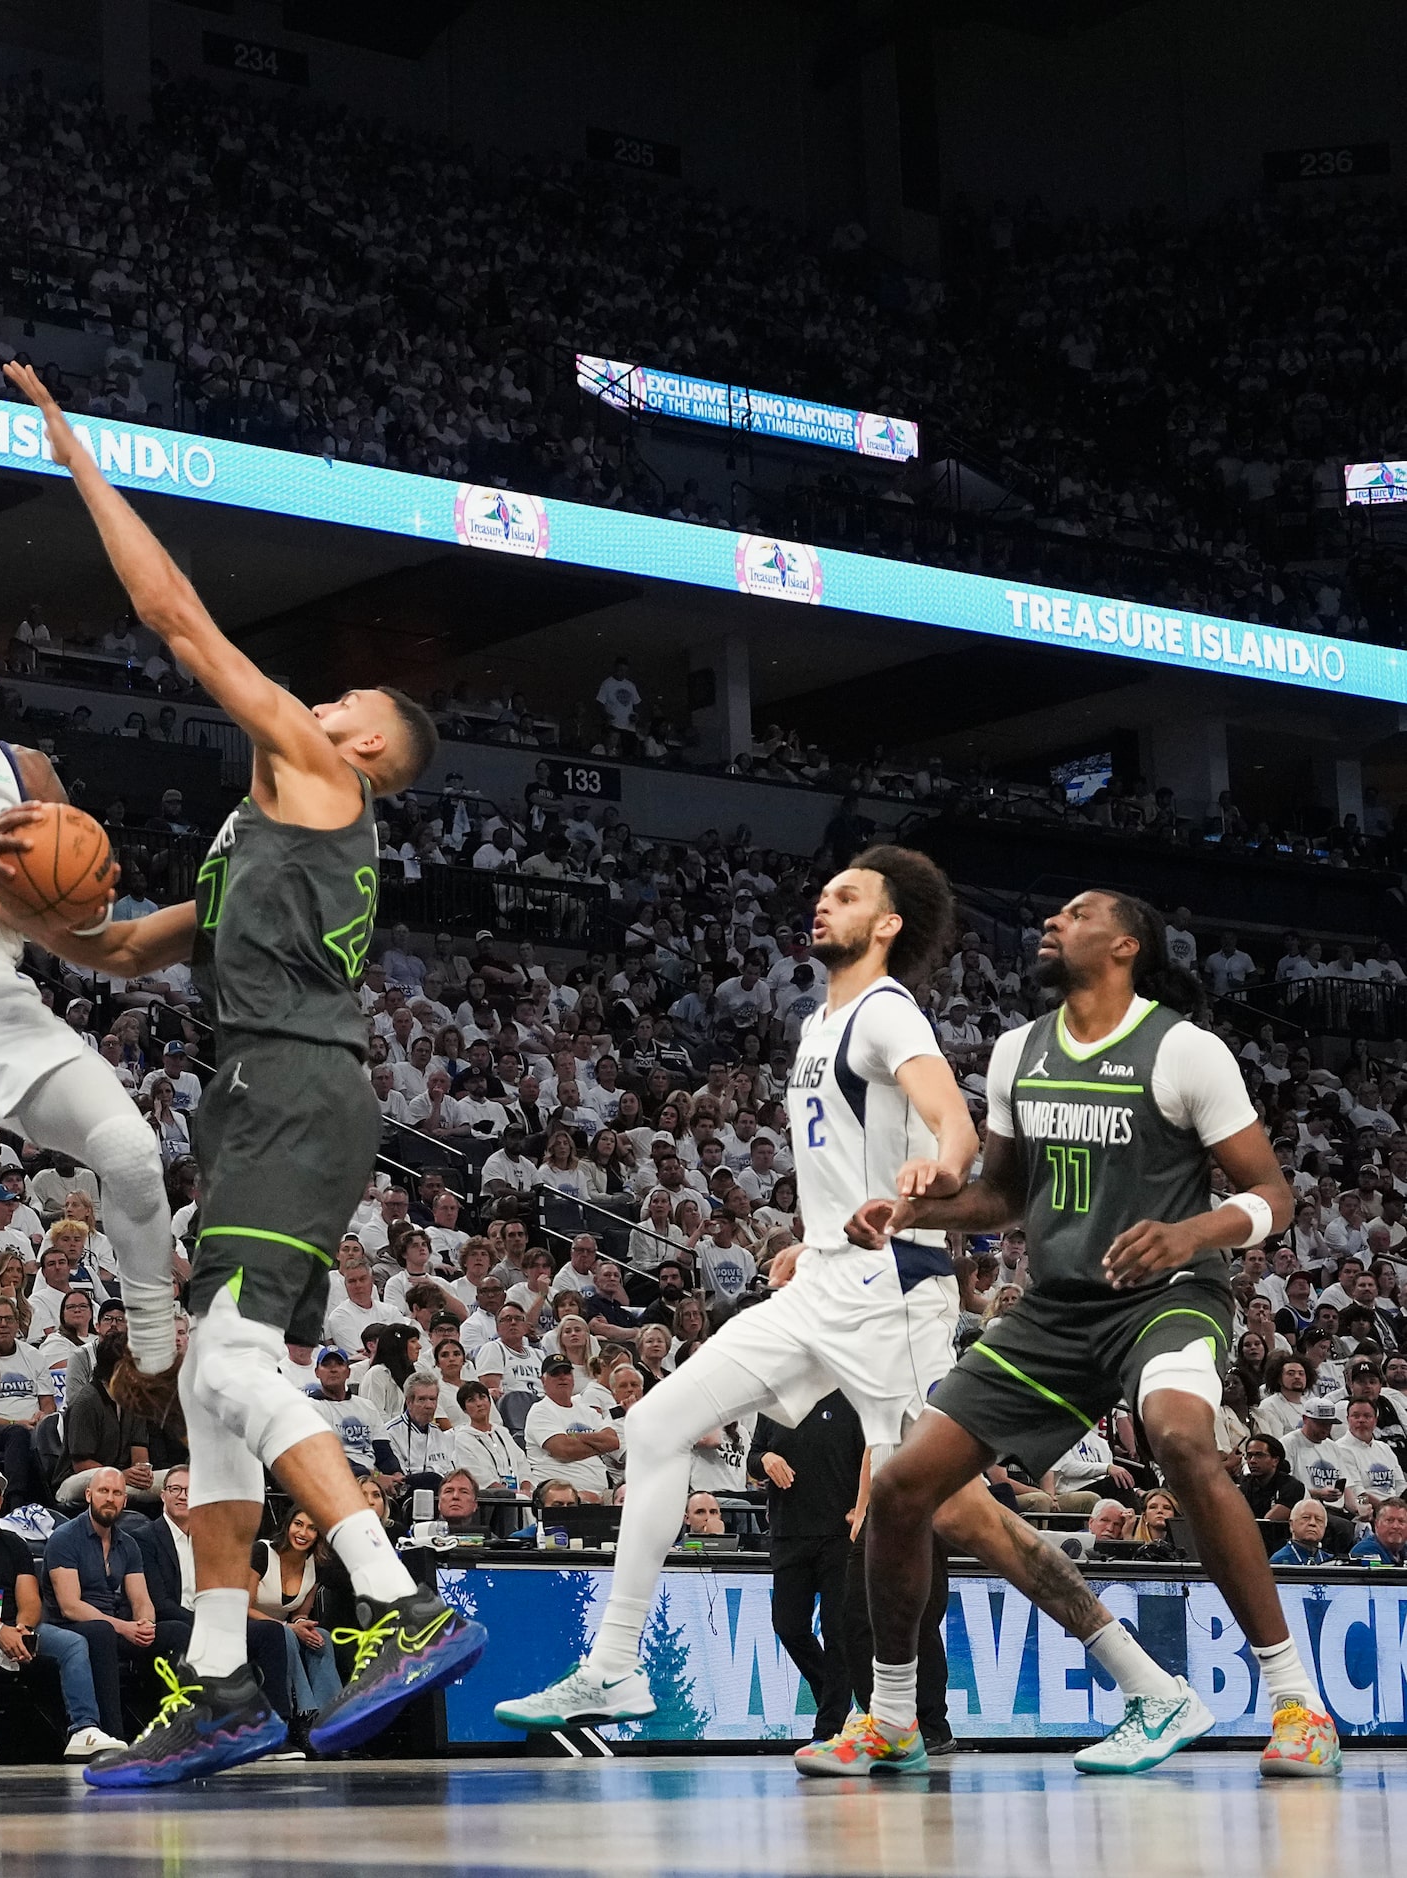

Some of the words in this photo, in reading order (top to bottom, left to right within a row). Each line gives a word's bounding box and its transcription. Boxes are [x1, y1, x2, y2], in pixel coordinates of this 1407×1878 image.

[234, 42, 279, 75] 234
[614, 137, 655, 167] 235
[1300, 149, 1353, 177] 236
[646, 372, 727, 407] EXCLUSIVE
[787, 402, 854, 432] PARTNER
[648, 393, 666, 407] OF
[667, 395, 691, 412] THE
[764, 413, 855, 447] TIMBERWOLVES
[866, 437, 891, 453] Treasure
[468, 517, 503, 538] Treasure
[511, 524, 536, 544] Island
[748, 566, 780, 588] Treasure
[787, 572, 810, 591] Island
[1005, 589, 1186, 656] TREASURE
[1191, 622, 1311, 676] ISLAND
[562, 767, 602, 793] 133
[806, 1096, 826, 1148] 2
[1017, 1100, 1134, 1149] TIMBERWOLVES
[1046, 1144, 1091, 1213] 11
[1360, 1362, 1370, 1371] M
